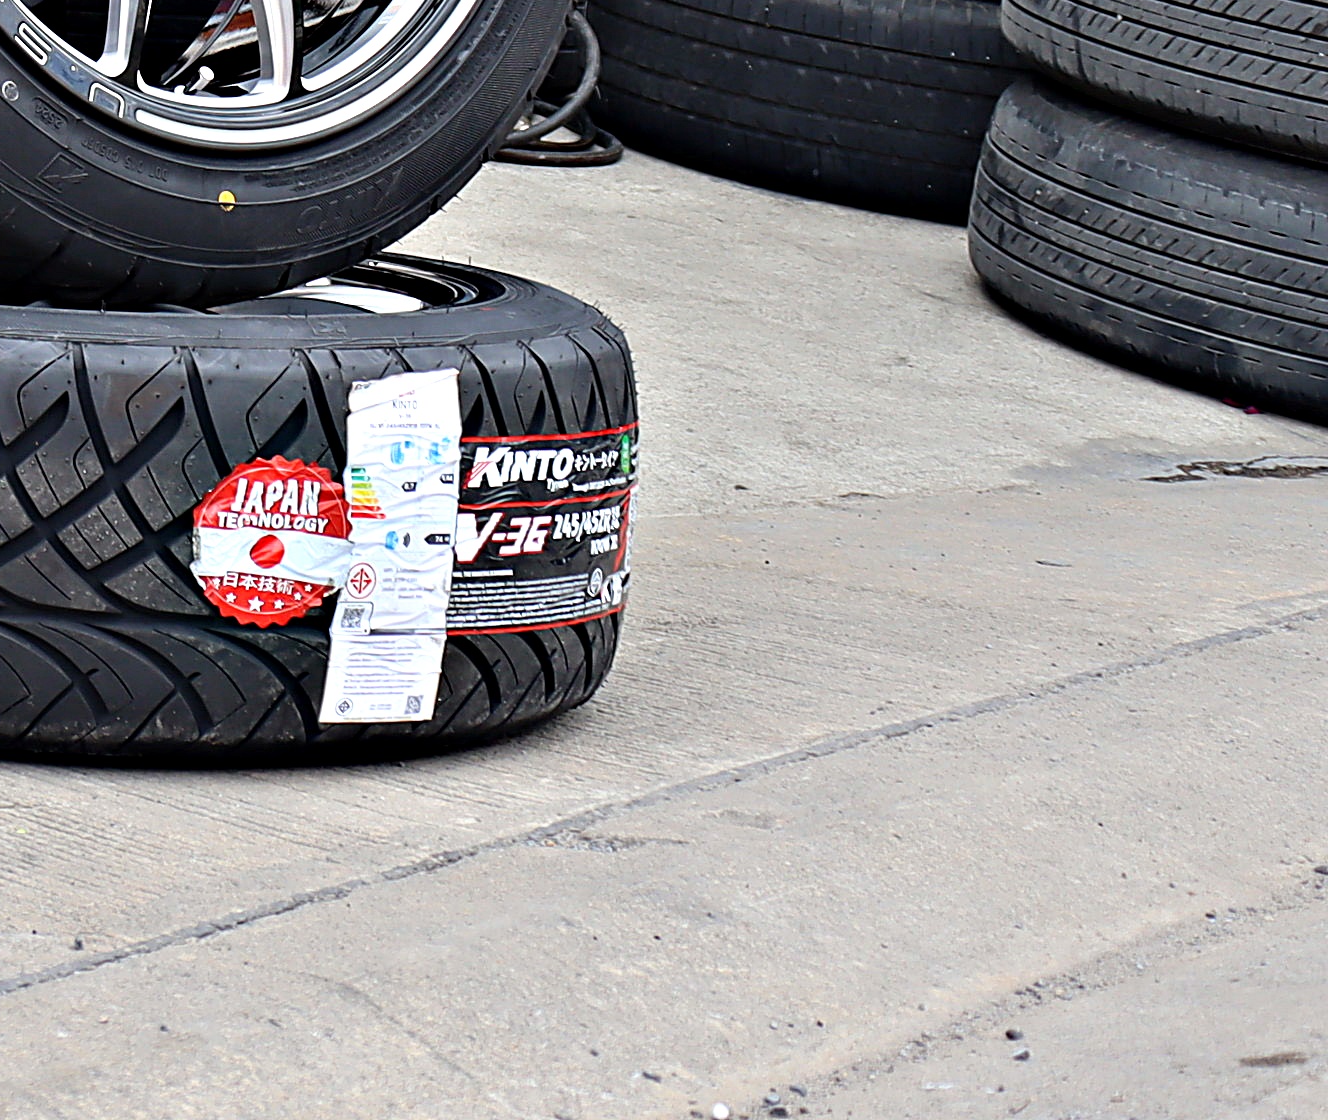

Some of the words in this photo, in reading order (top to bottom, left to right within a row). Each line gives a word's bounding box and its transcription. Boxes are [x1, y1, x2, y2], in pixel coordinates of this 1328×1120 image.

[392, 400, 418, 410] KINTO
[467, 446, 574, 488] KINTO
[231, 477, 320, 516] JAPAN
[455, 512, 553, 564] V-36
[223, 570, 295, 598] 日本技術
